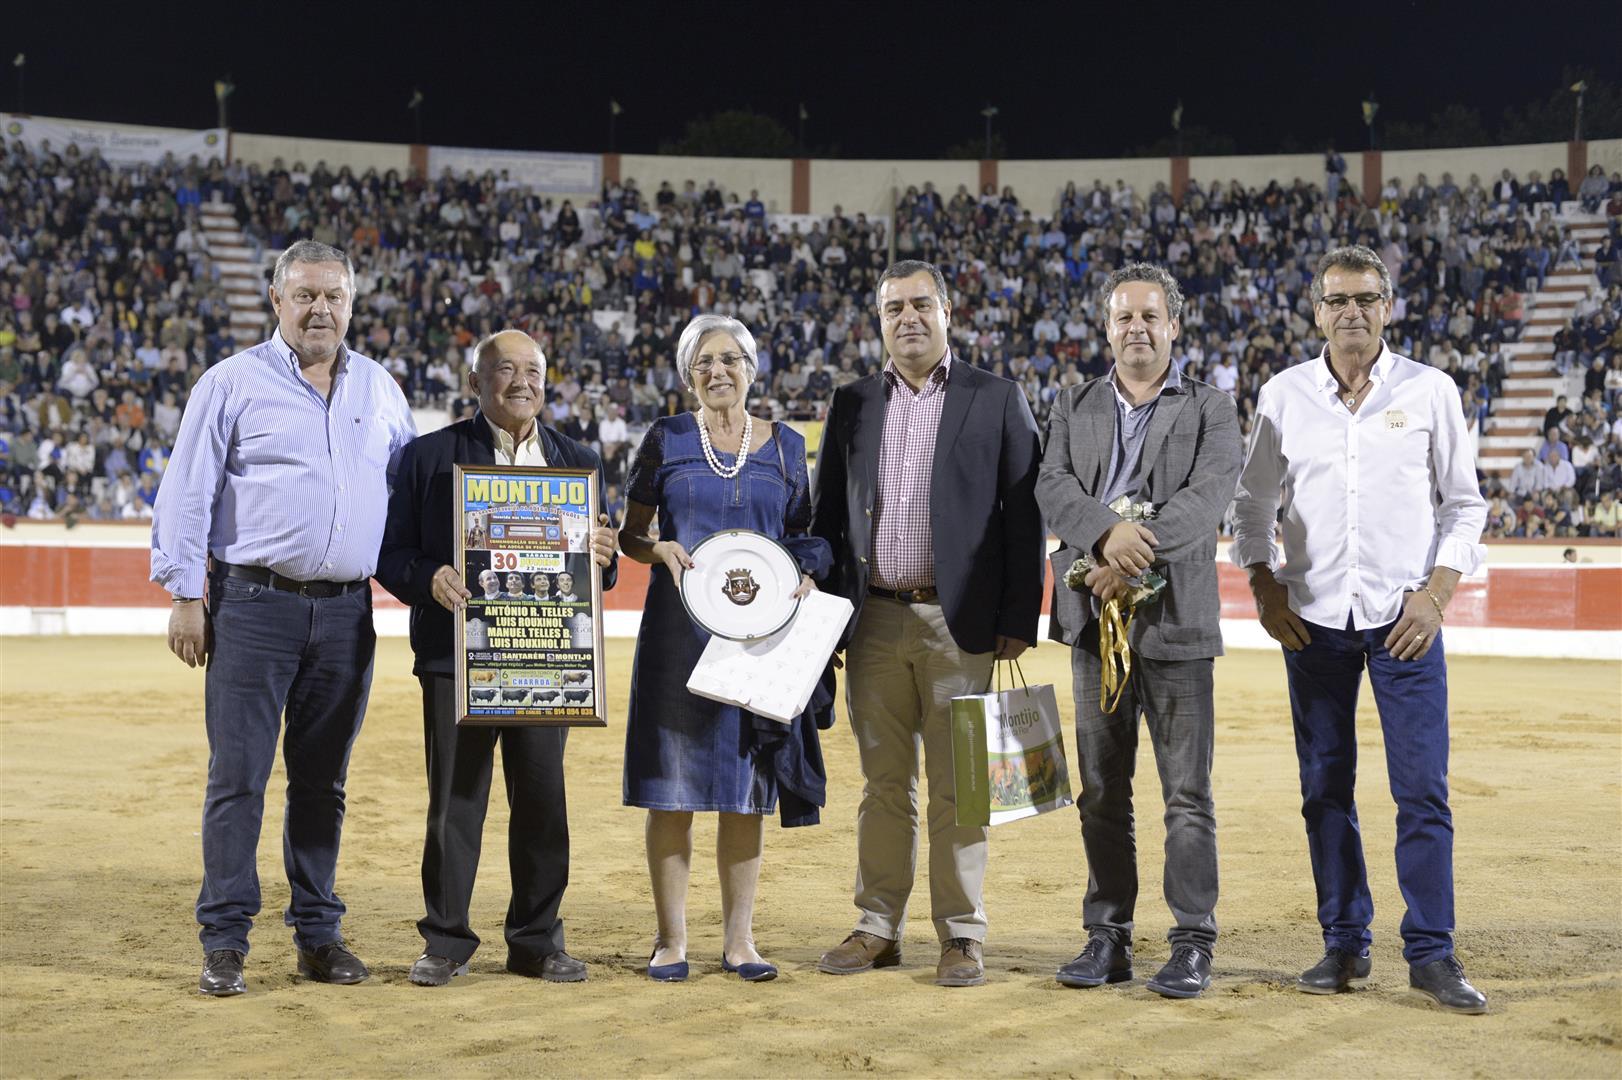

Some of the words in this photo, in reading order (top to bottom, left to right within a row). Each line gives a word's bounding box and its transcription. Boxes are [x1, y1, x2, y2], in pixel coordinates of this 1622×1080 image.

[1389, 421, 1404, 429] 242
[467, 479, 586, 505] MONTIJO
[494, 552, 517, 570] 30
[485, 605, 529, 616] ANTÓNIO
[530, 607, 539, 617] R.
[541, 607, 574, 618] TELLES
[496, 617, 517, 627] LUIS
[518, 618, 563, 628] ROUXINOL
[487, 627, 527, 637] MANUEL
[528, 628, 561, 638] TELLES
[562, 629, 573, 639] B.
[489, 638, 511, 648] LUIS
[512, 638, 559, 649] ROUXINOL
[560, 639, 571, 649] JR
[502, 651, 545, 660] SANTARÉM
[502, 671, 508, 679] 6
[554, 671, 560, 680] 6
[1000, 708, 1040, 729] Montijo
